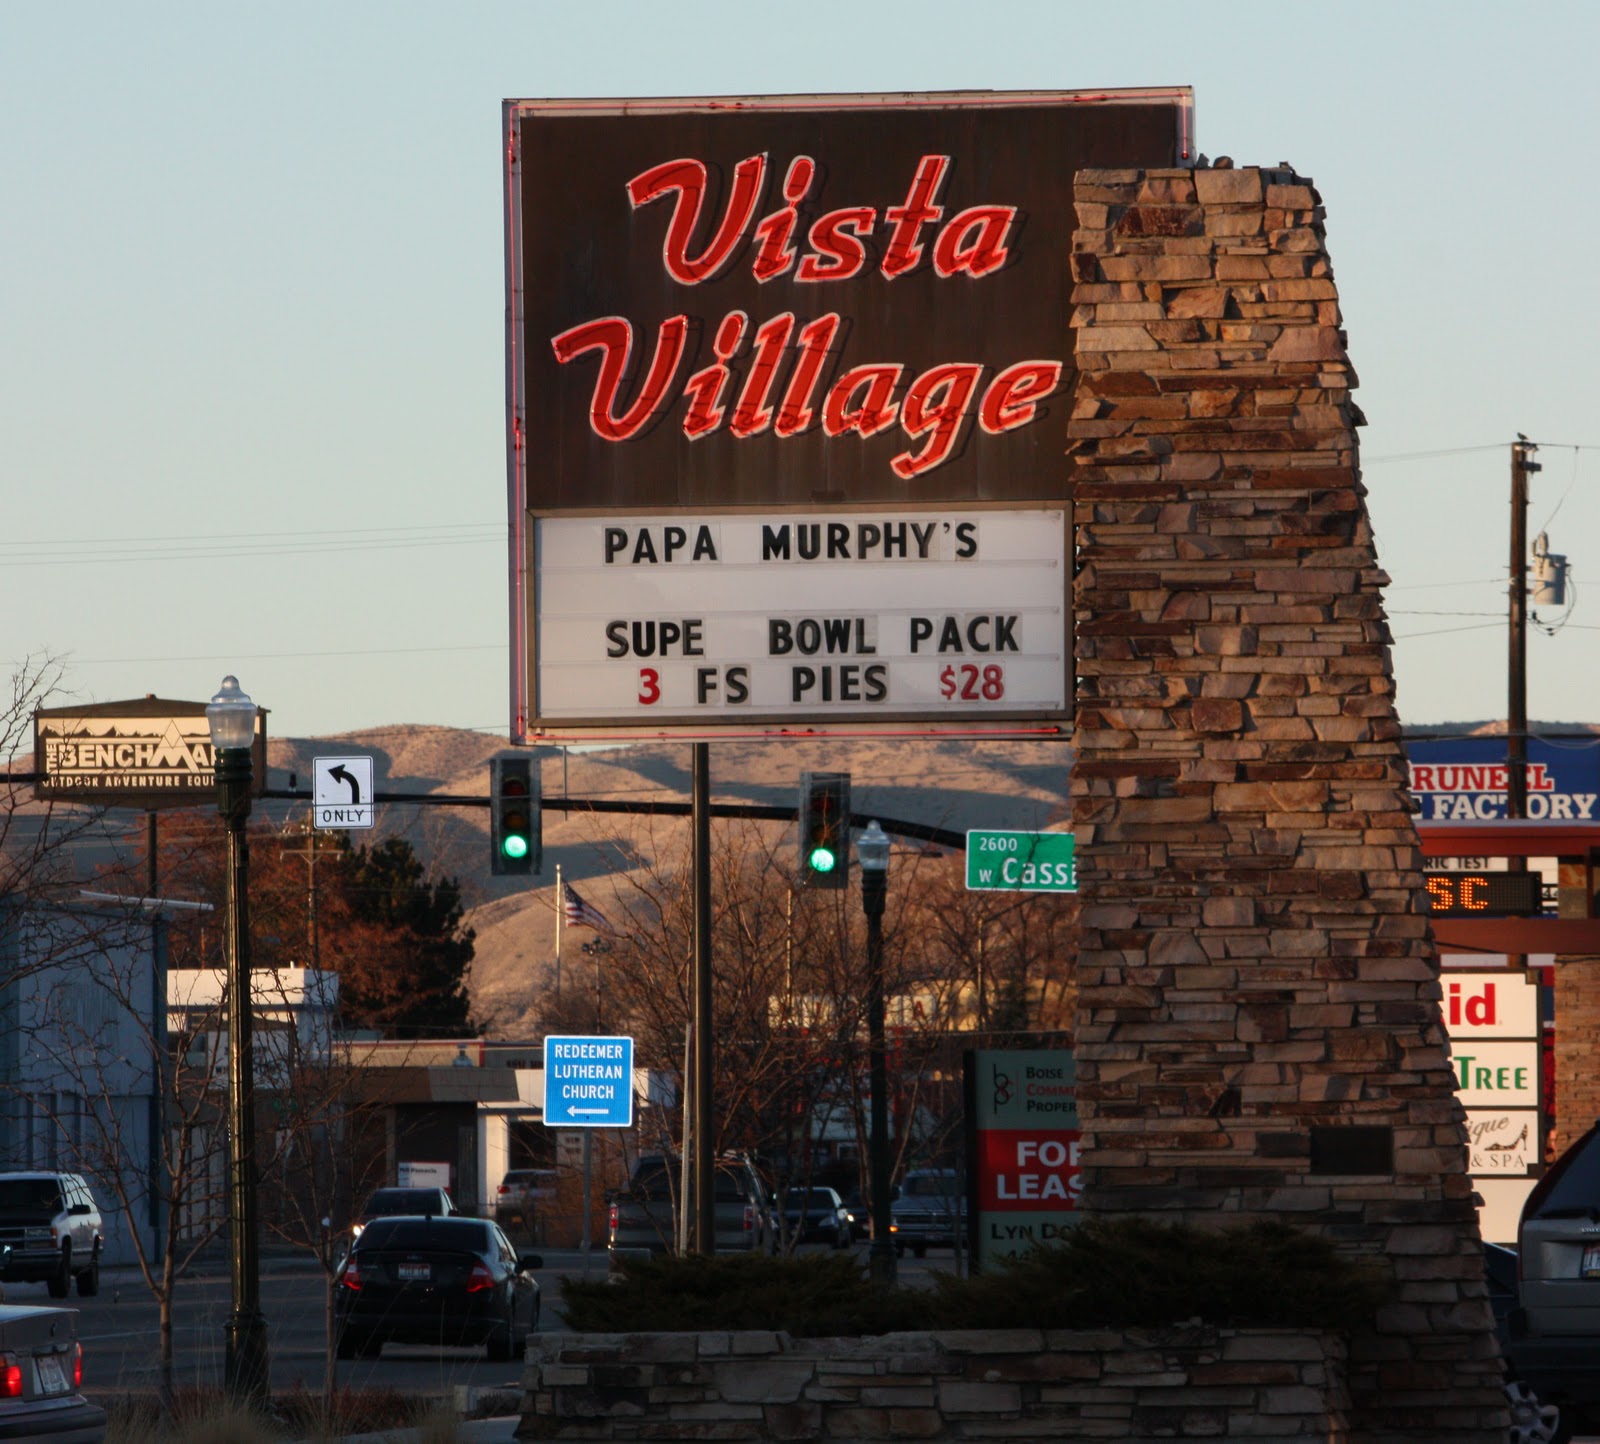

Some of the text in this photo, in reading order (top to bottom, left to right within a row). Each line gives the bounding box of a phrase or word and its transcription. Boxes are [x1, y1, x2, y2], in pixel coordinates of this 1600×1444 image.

[626, 152, 1017, 285] Vista
[551, 311, 1063, 479] Village
[604, 522, 977, 564] PAPA MURPHY'S
[606, 615, 1020, 658] SUPE BOWL PACK
[638, 664, 1004, 704] 3 FS PIES $28
[105, 776, 180, 787] ADVENTURE
[322, 808, 364, 822] ONLY
[979, 837, 1018, 851] 2600
[1441, 983, 1496, 1026] id
[555, 1044, 623, 1058] REDEEMER
[554, 1065, 622, 1078] LUTHERAN
[562, 1085, 614, 1099] CHURCH
[1470, 1153, 1526, 1168] & SPA
